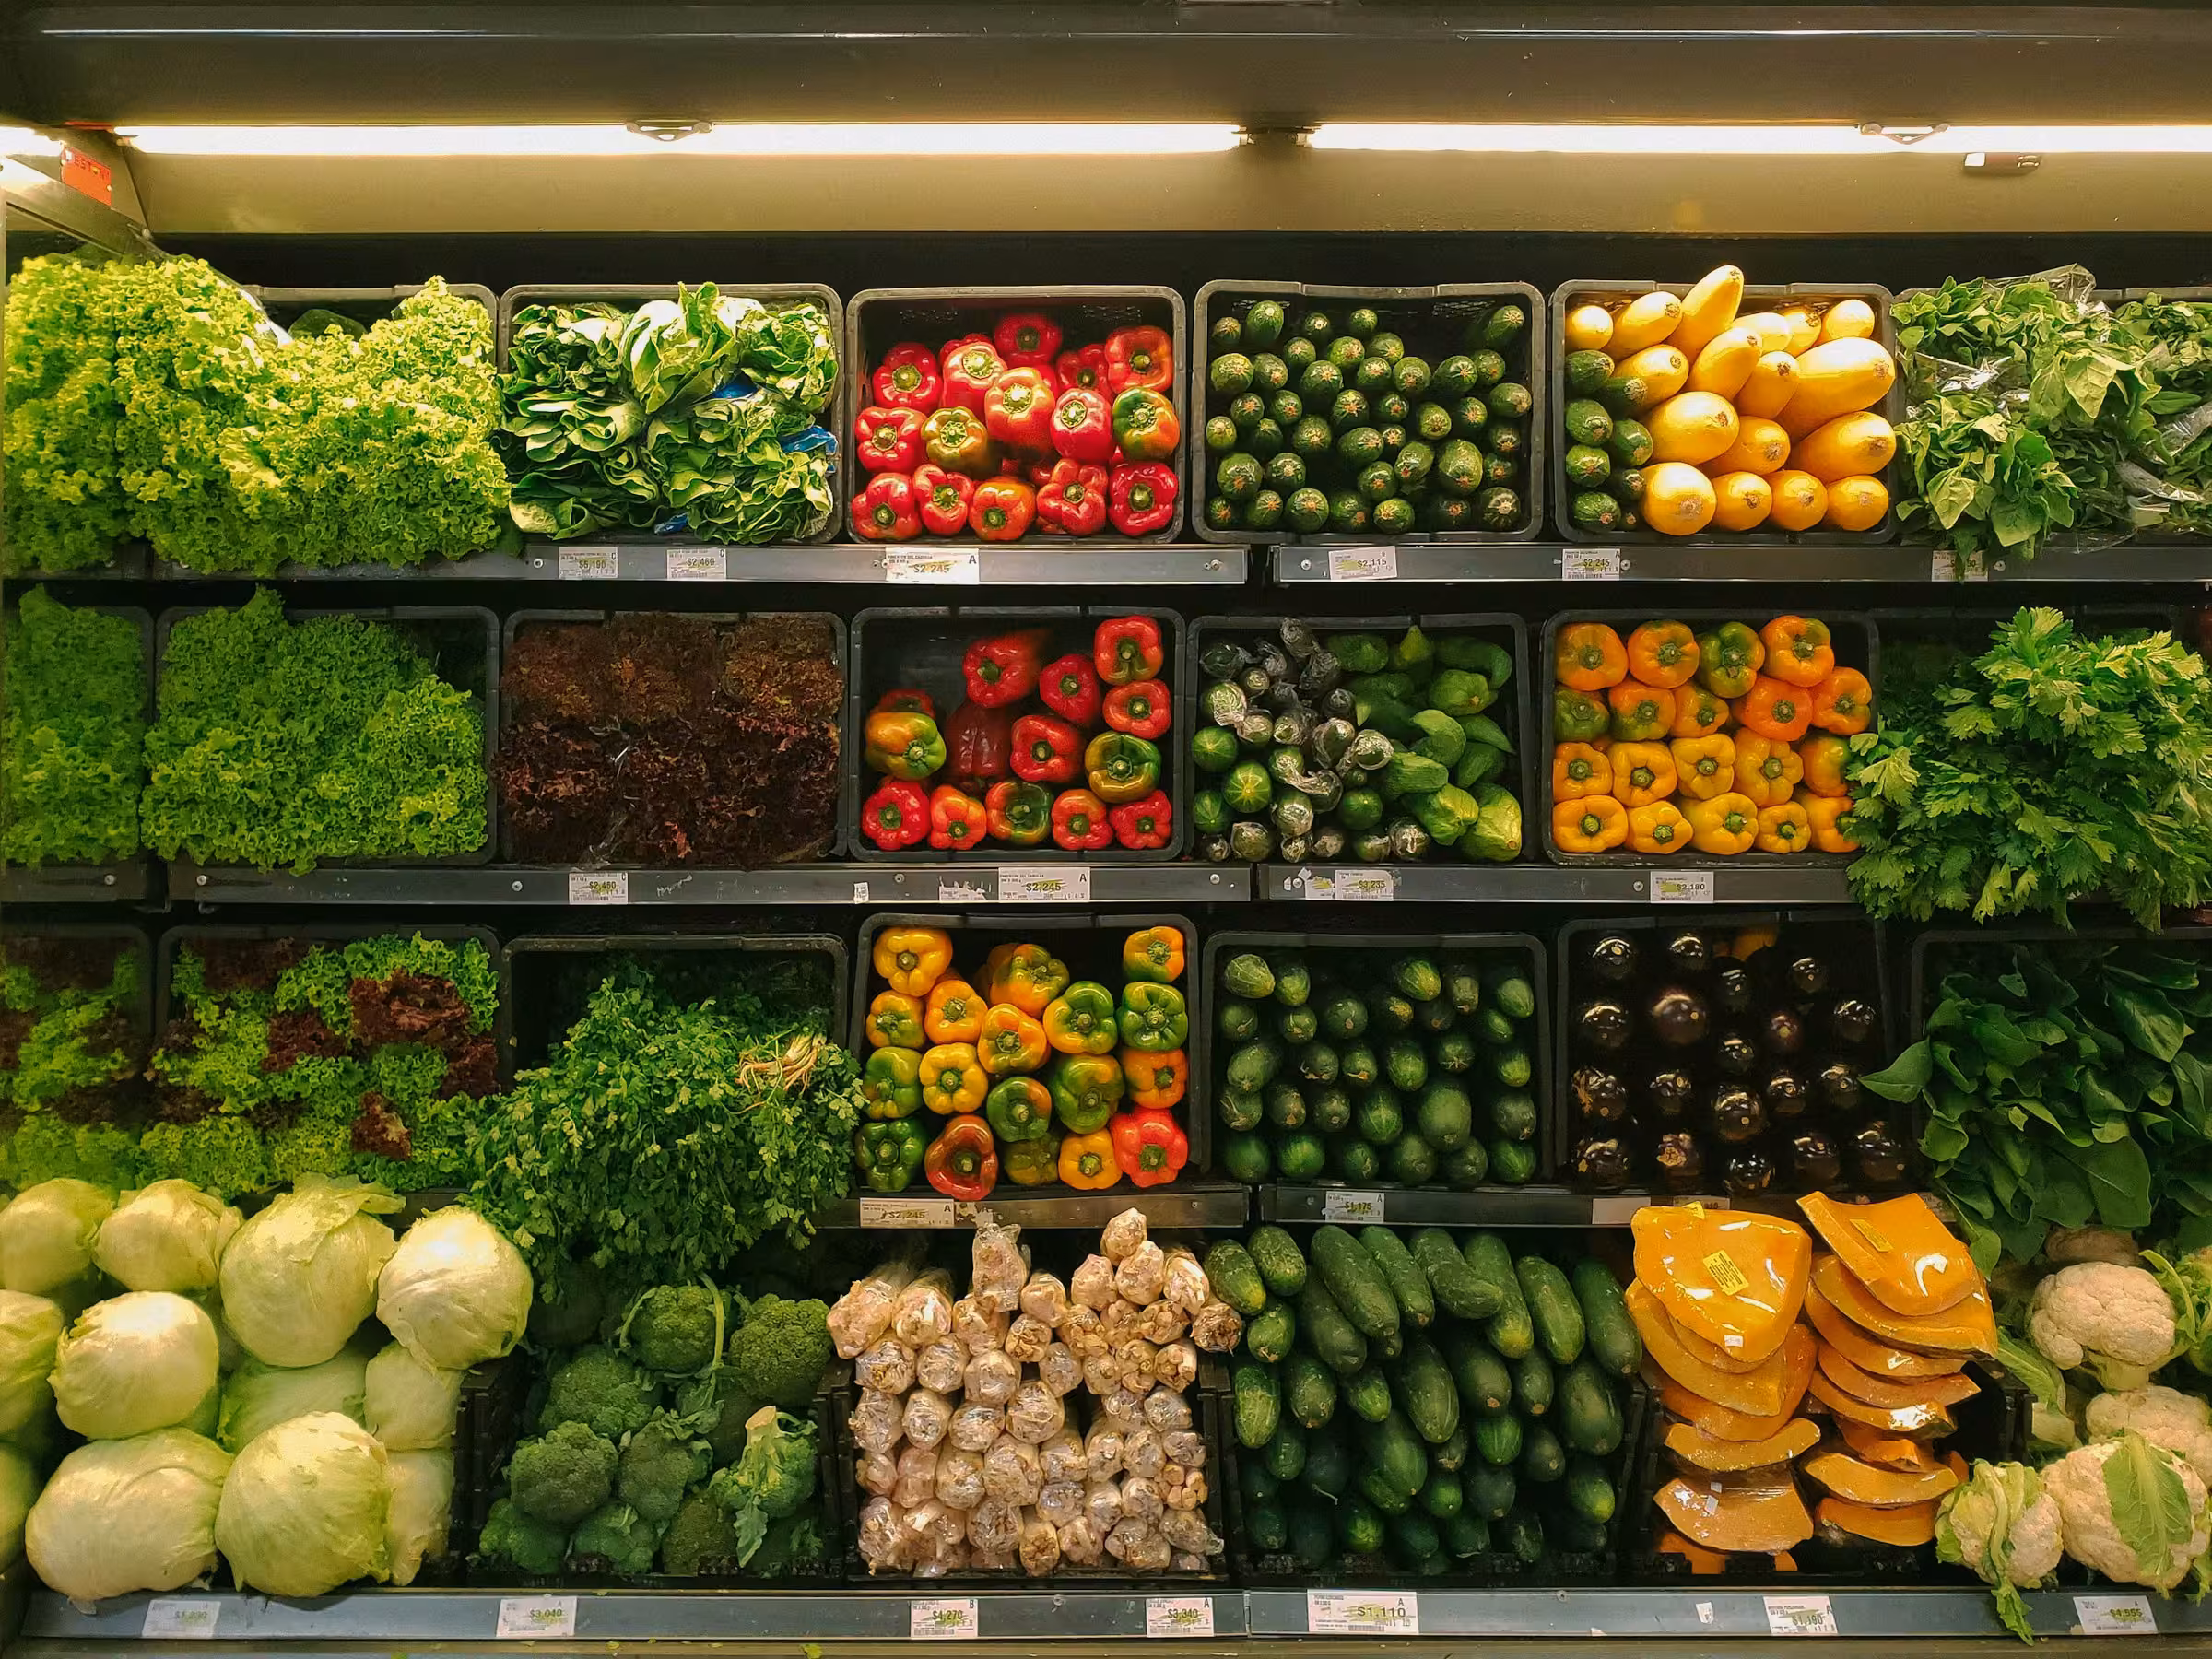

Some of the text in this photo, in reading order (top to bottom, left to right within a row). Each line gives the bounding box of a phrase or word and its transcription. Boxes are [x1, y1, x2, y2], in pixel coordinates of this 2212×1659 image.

[719, 548, 724, 558] C
[969, 555, 977, 565] A
[1357, 558, 1387, 569] $2,115
[913, 563, 950, 574] $2245
[1079, 873, 1088, 883] A
[1026, 882, 1062, 893] $2,245
[1676, 883, 1706, 891] $2,180
[1377, 1194, 1382, 1203] A
[944, 1204, 952, 1213] A
[888, 1211, 925, 1220] $2,245
[969, 1599, 975, 1609] B
[1204, 1597, 1210, 1608] A
[1397, 1597, 1405, 1606] A
[1357, 1606, 1406, 1618] $1,110
[1826, 1606, 1832, 1615] A
